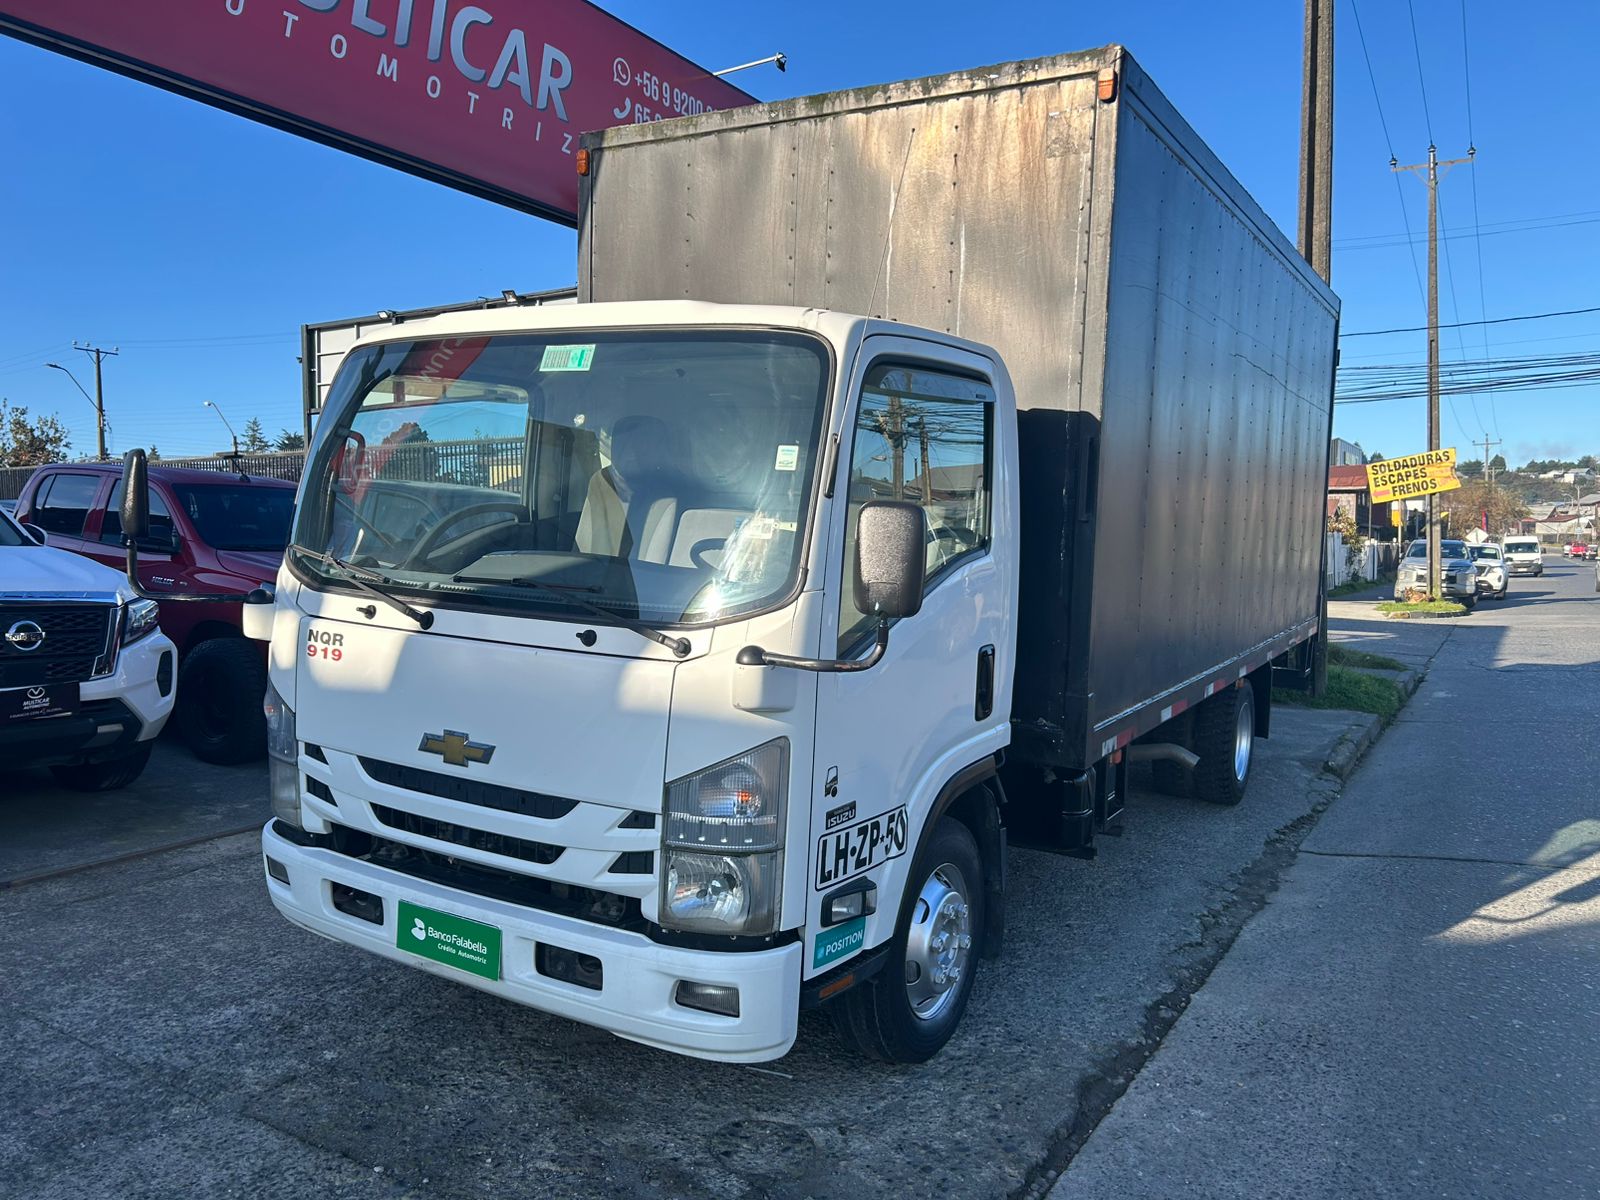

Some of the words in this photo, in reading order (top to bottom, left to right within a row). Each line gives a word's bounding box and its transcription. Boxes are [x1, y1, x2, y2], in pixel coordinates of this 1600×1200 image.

[635, 70, 659, 101] +56
[662, 82, 670, 107] 9
[1371, 450, 1450, 475] SOLDADURAS
[1373, 467, 1427, 488] ESCAPES
[1391, 478, 1437, 497] FRENOS
[307, 628, 344, 647] NQR
[307, 644, 343, 661] 919
[827, 809, 855, 828] ISUZU
[825, 929, 863, 956] POSITION
[457, 950, 487, 964] Automotriz
